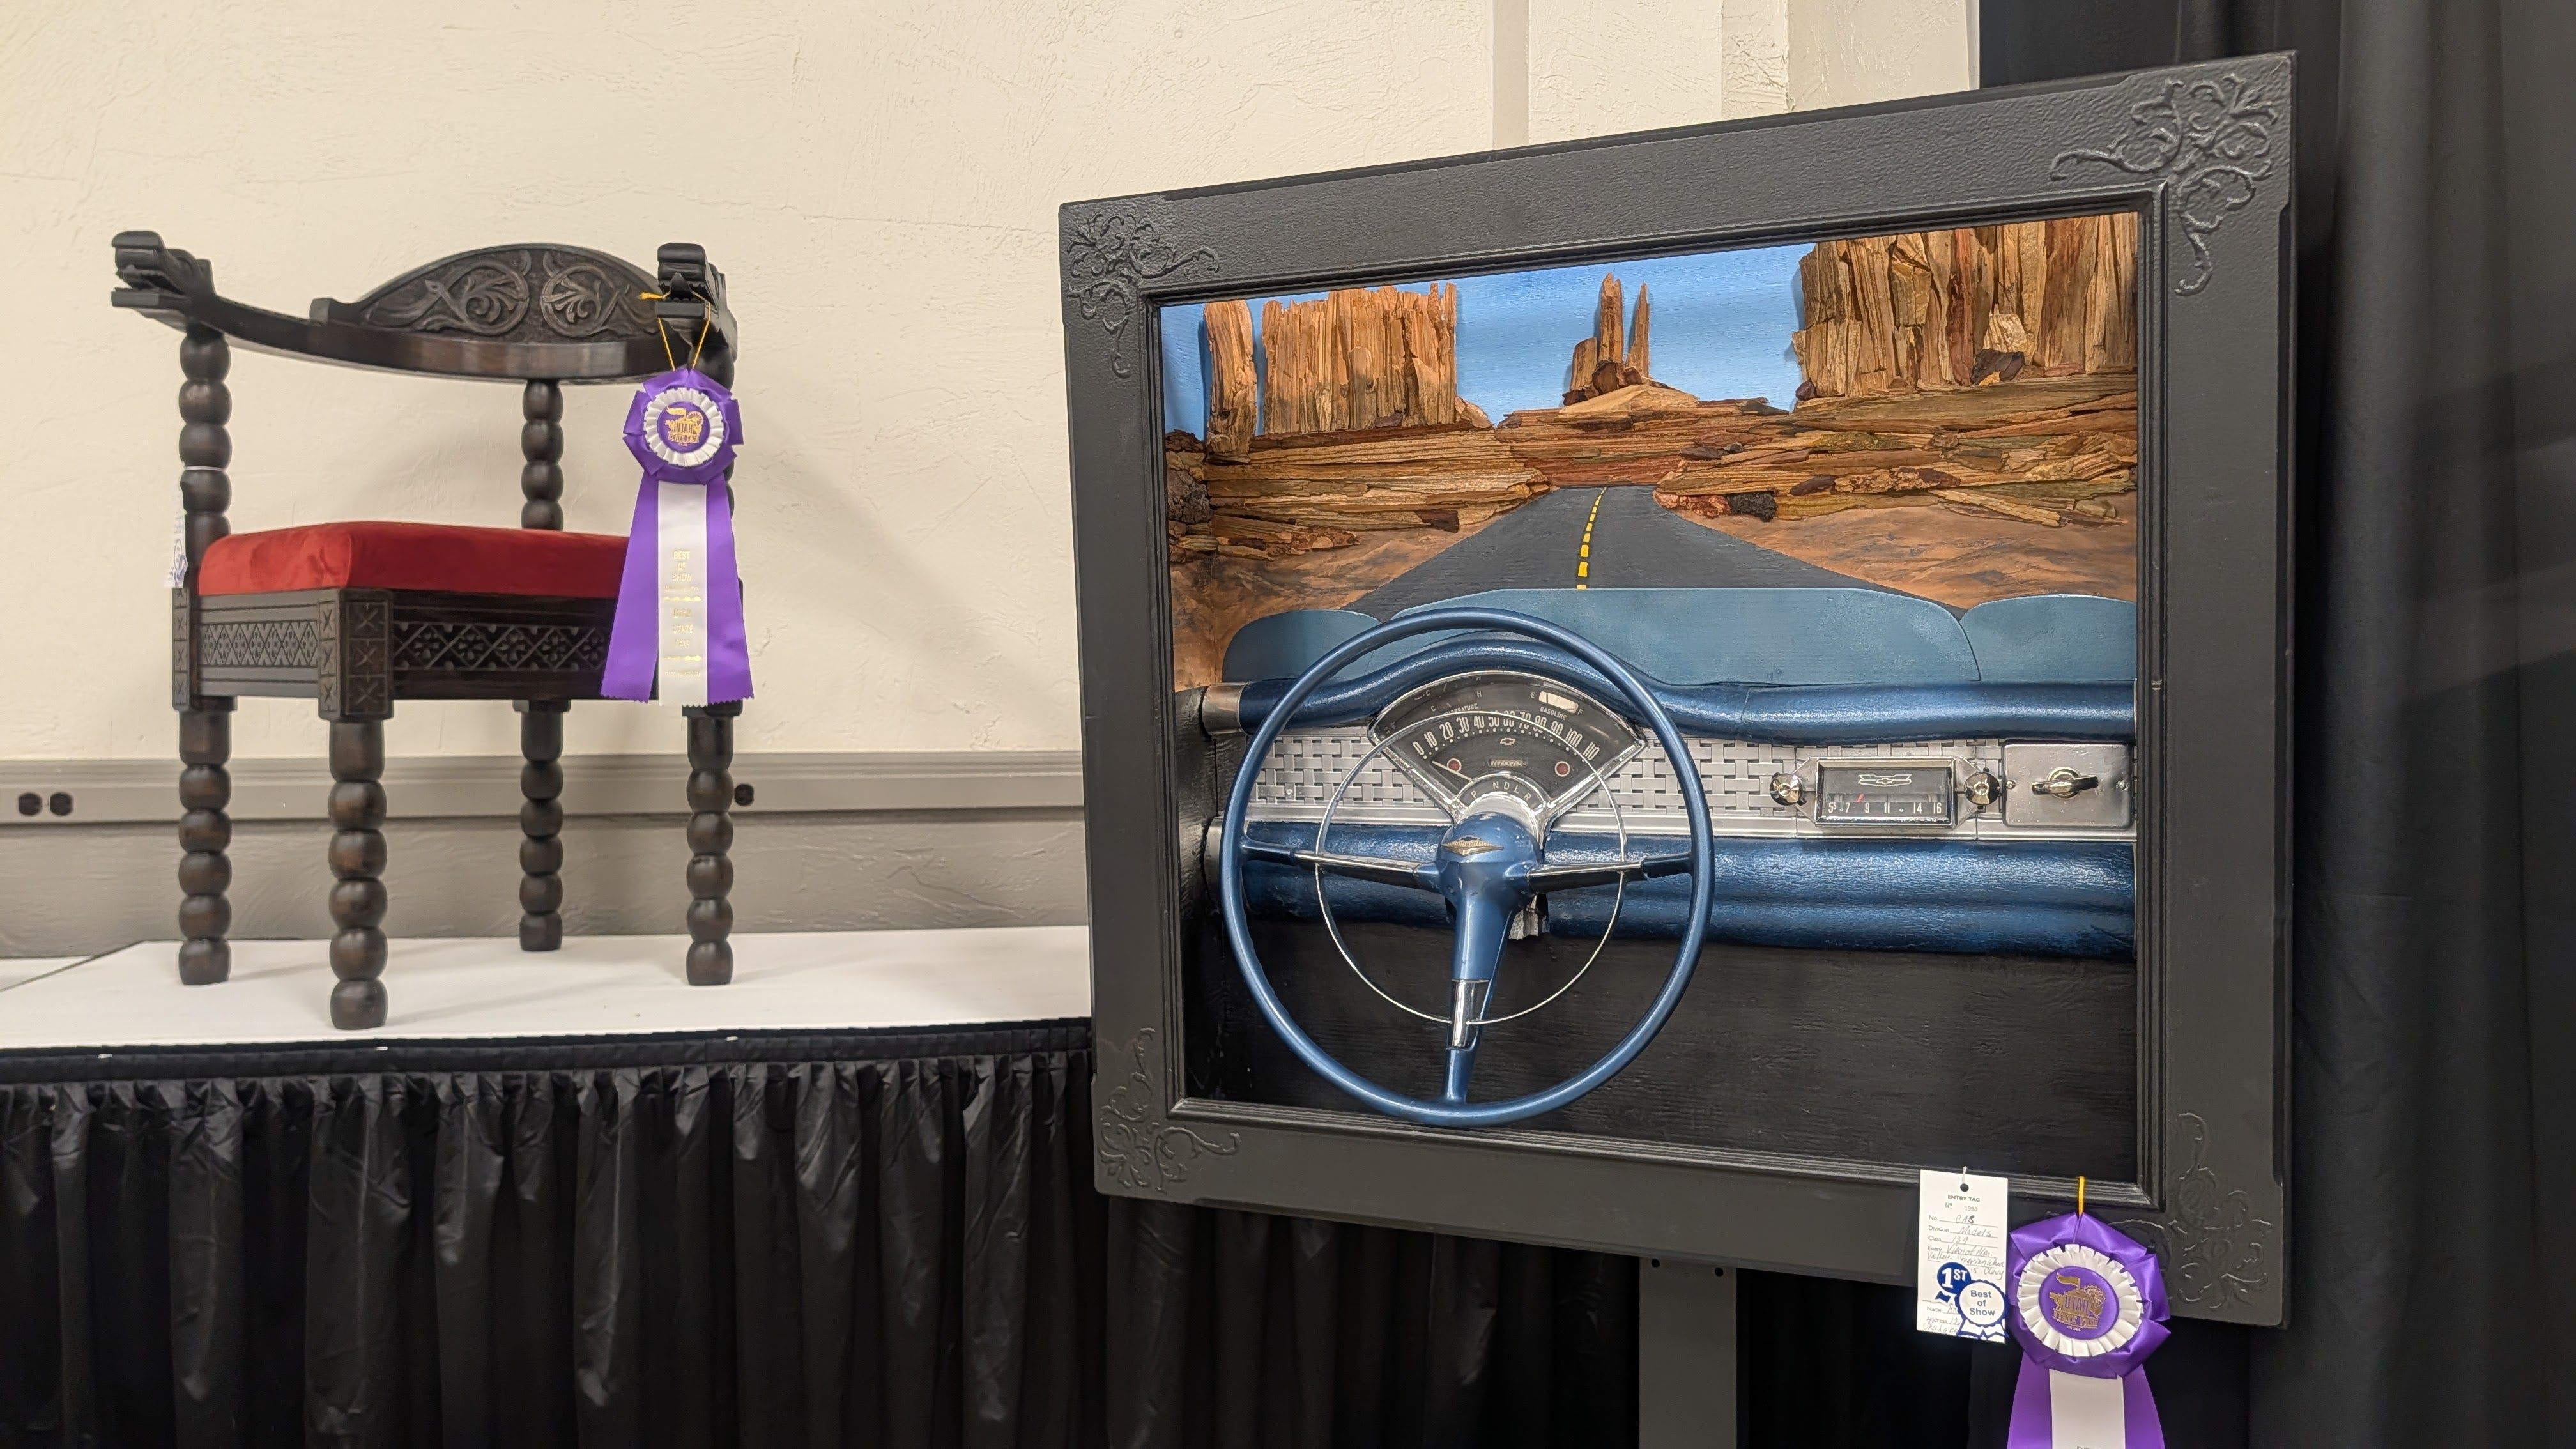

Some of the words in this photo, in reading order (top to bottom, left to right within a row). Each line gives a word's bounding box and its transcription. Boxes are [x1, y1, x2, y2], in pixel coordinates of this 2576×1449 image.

[673, 550, 690, 560] BEST
[1540, 706, 1567, 720] GASOLINE
[1413, 741, 1425, 756] 0
[1423, 731, 1438, 748] 10
[1439, 721, 1454, 740] 20
[1456, 716, 1469, 733] 30
[1473, 716, 1485, 729] 40
[1549, 721, 1564, 737] 90
[1565, 728, 1583, 748] 100
[1583, 742, 1600, 761] 110
[1471, 790, 1476, 799] P
[1503, 781, 1510, 790] D
[1514, 785, 1519, 793] L
[1524, 792, 1531, 801] R
[1845, 802, 1850, 813] 7
[1864, 802, 1870, 813] 9
[1884, 802, 1890, 814] 11
[1913, 802, 1922, 813] 14
[1933, 802, 1942, 813] 16
[1942, 1267, 1968, 1289] 1ST
[1969, 1307, 1995, 1316] Show
